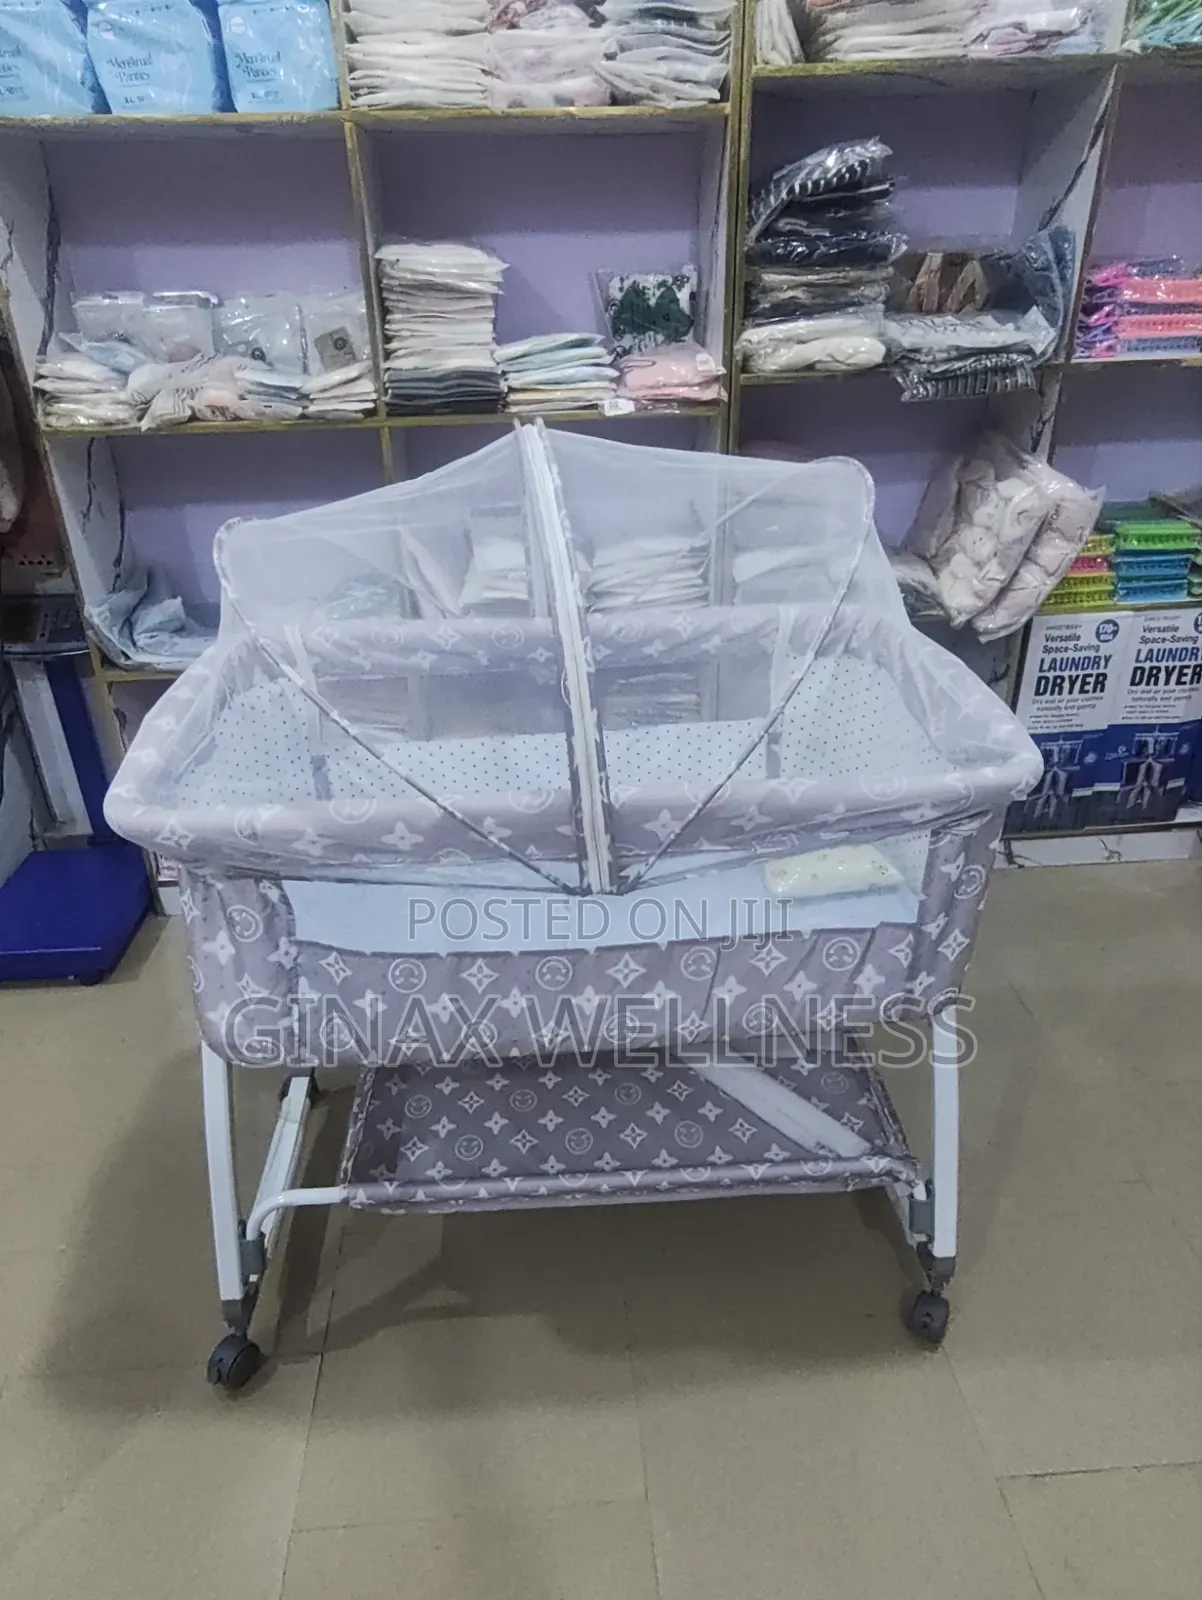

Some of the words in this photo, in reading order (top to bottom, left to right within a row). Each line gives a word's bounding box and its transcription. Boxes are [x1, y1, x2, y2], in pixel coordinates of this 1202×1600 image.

[1142, 624, 1180, 633] Versatile
[1044, 633, 1082, 643] Versatile
[1138, 635, 1199, 645] Space-Saving
[1041, 643, 1101, 655] Space-Saving
[1038, 654, 1113, 673] LAUNDRY
[1129, 664, 1202, 687] DRYER
[1034, 672, 1109, 697] DRYER
